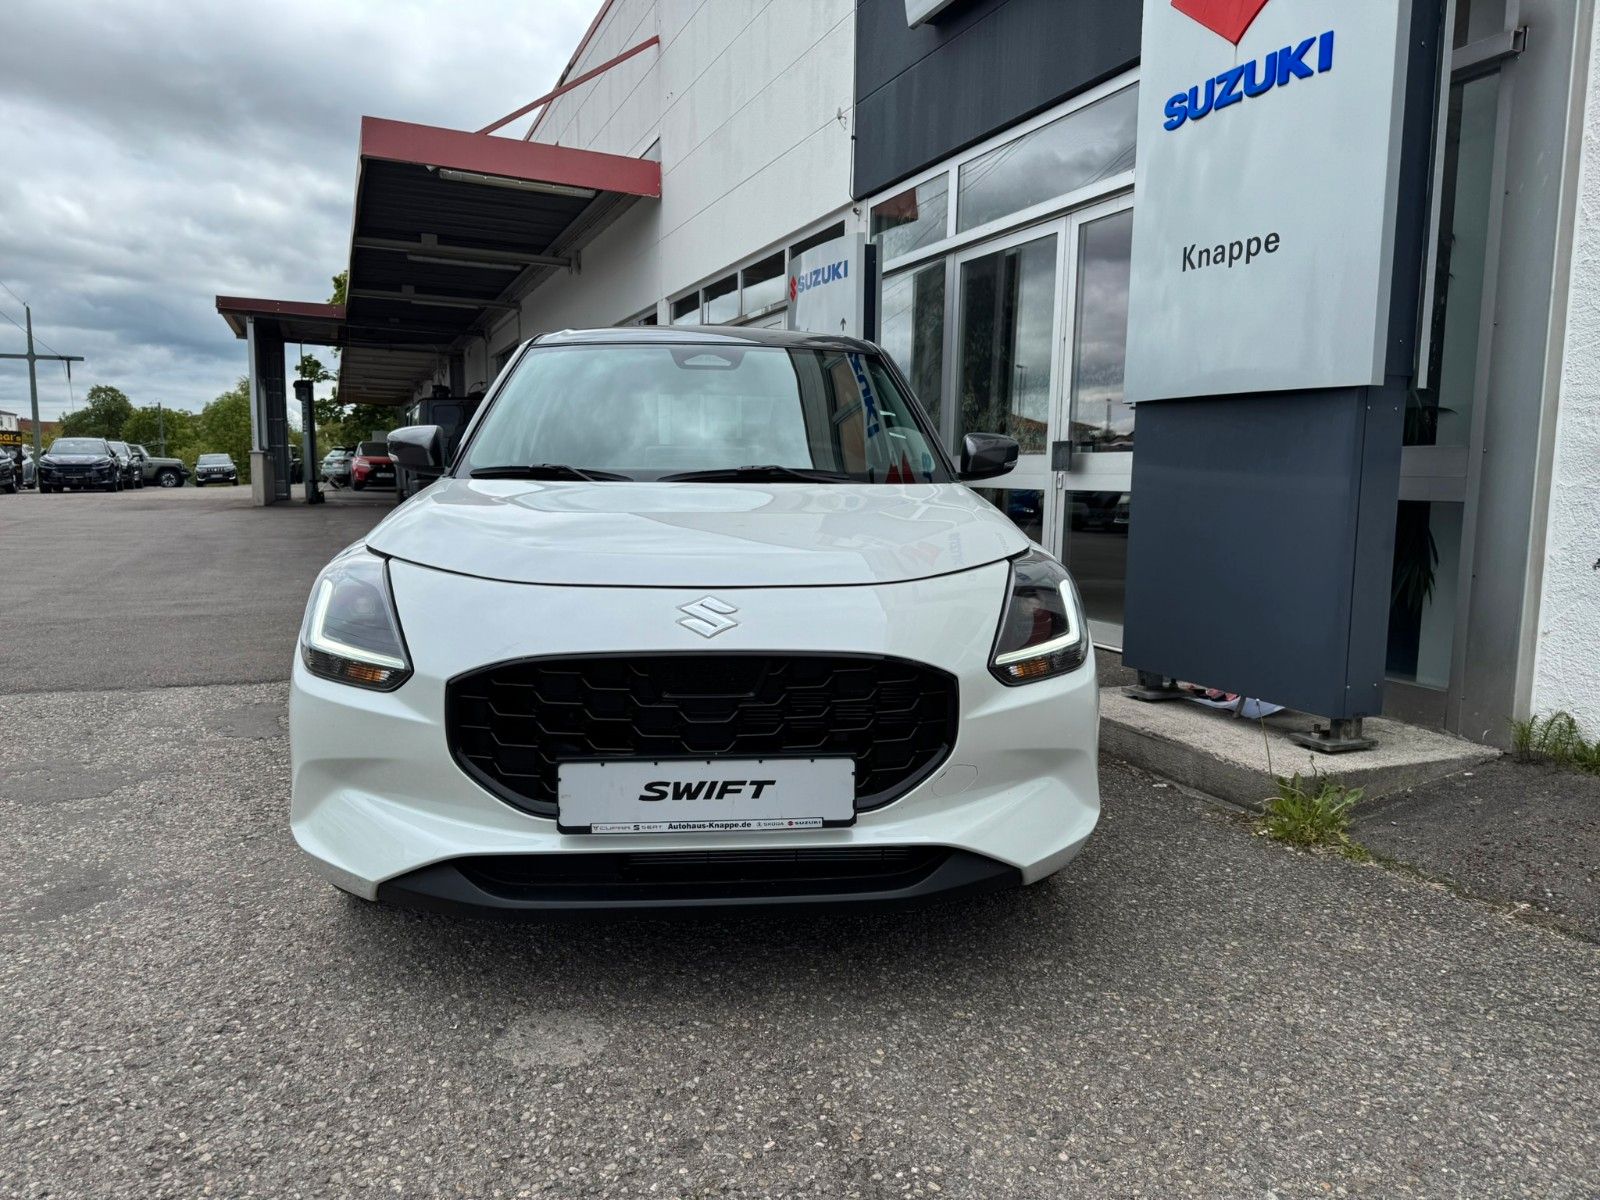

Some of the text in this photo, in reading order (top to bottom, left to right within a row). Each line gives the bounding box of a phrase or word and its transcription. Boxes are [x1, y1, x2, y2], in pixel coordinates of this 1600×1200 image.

[1163, 30, 1335, 132] SUZUKI
[1181, 231, 1281, 272] Knappe
[797, 259, 849, 293] SUZUKI
[638, 779, 777, 802] SWIFT
[667, 820, 752, 831] Autohaus-Knappe.de
